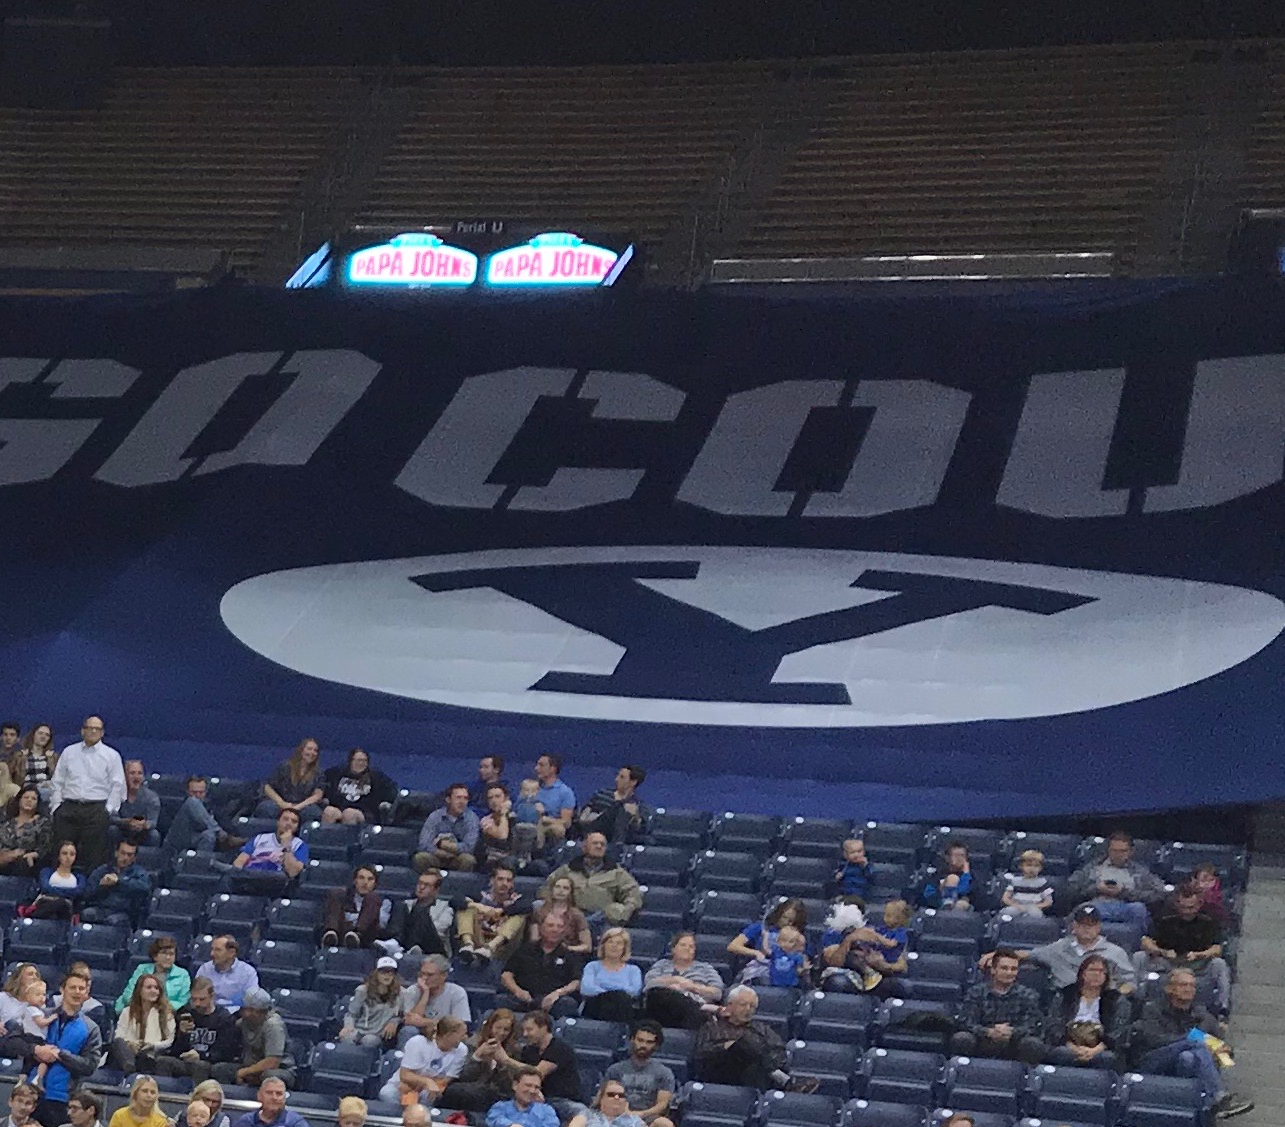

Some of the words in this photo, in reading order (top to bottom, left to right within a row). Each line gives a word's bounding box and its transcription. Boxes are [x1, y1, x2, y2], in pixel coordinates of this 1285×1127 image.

[355, 250, 404, 277] PAPA
[494, 251, 543, 278] PAPA
[409, 559, 1101, 706] Y
